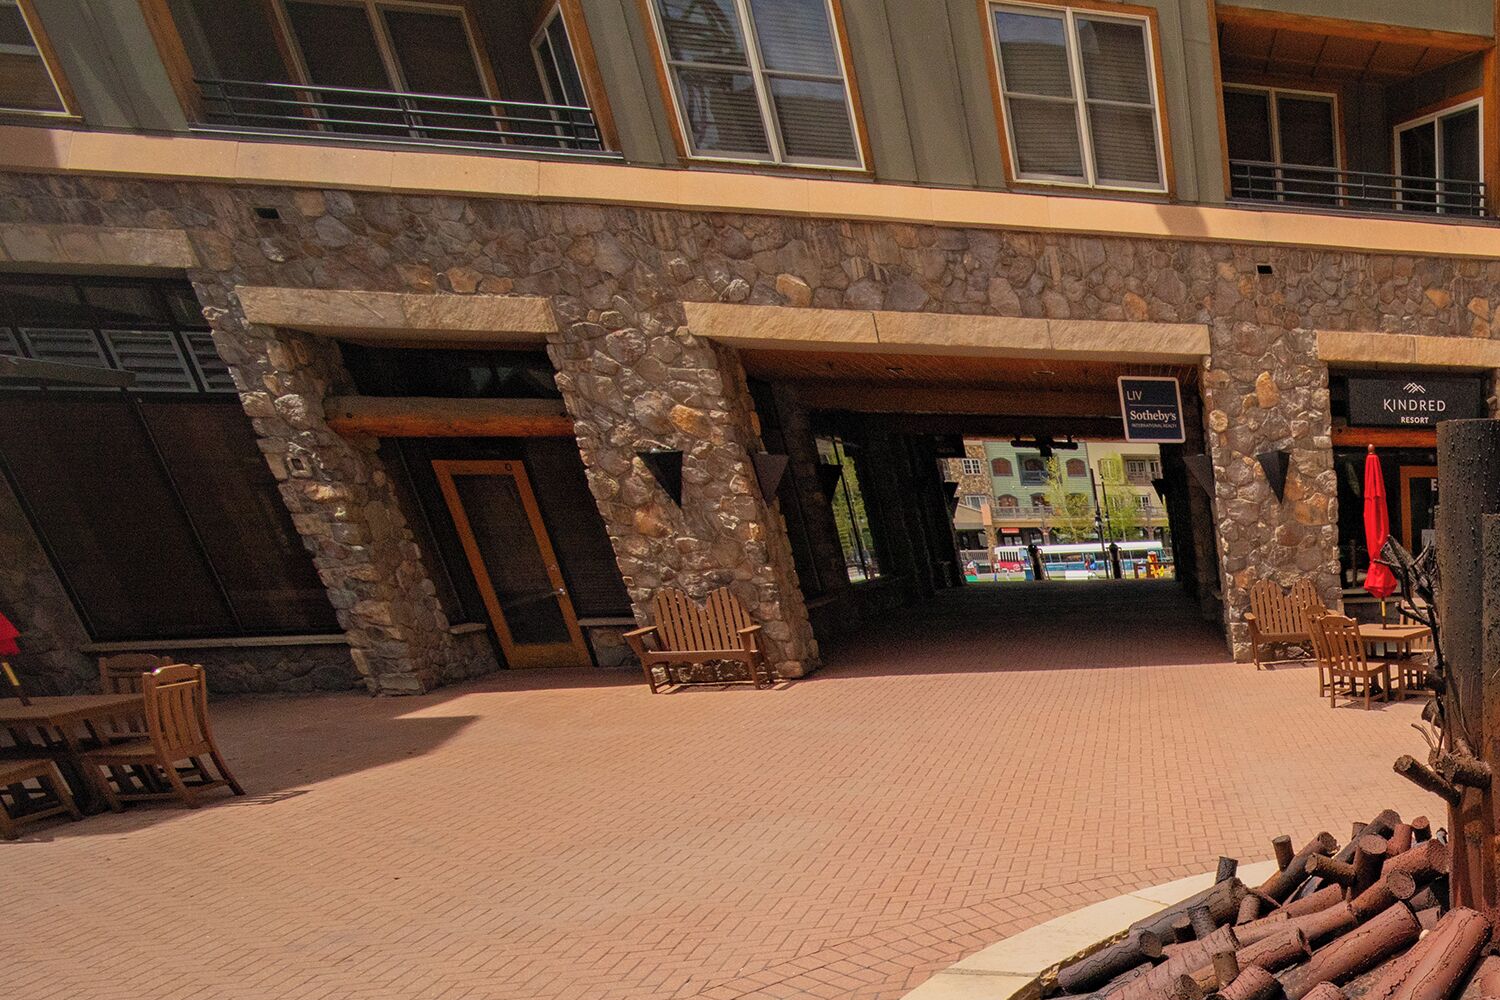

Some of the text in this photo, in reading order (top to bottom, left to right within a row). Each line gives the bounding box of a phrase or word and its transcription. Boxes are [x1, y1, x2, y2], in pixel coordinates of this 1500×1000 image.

[1126, 390, 1142, 401] LIV
[1383, 398, 1446, 413] KINDRED
[1130, 409, 1177, 423] Sotheby's
[1400, 416, 1429, 424] RESORT
